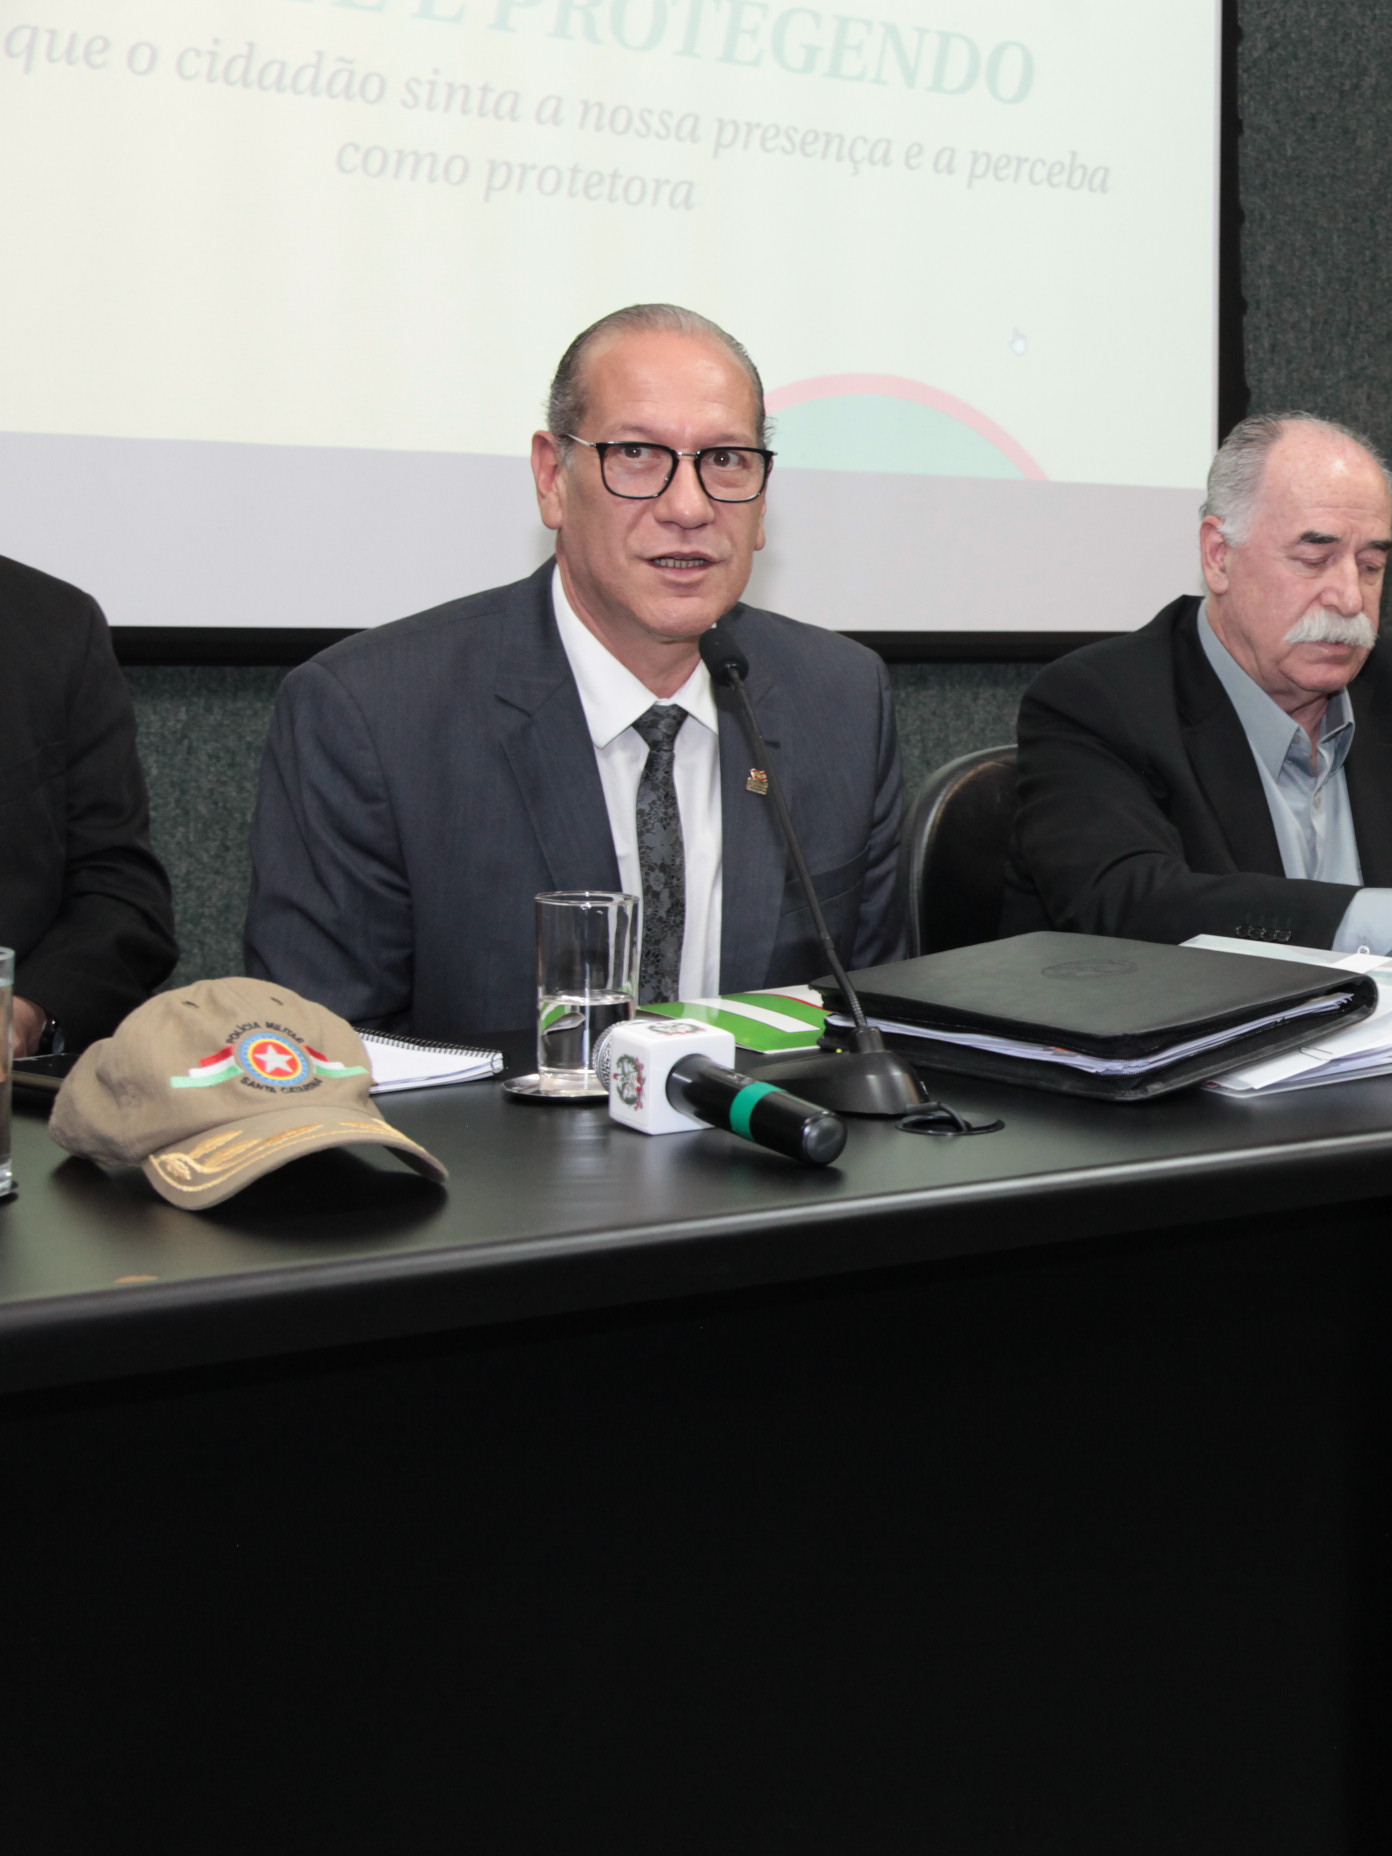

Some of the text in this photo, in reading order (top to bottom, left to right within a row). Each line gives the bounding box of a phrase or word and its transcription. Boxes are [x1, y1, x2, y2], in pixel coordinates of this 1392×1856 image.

[2, 22, 1111, 195] que o cidadão sinta a nossa presença e a perceba
[335, 140, 697, 212] como protetora
[240, 1076, 323, 1094] SANTA CATARINA
